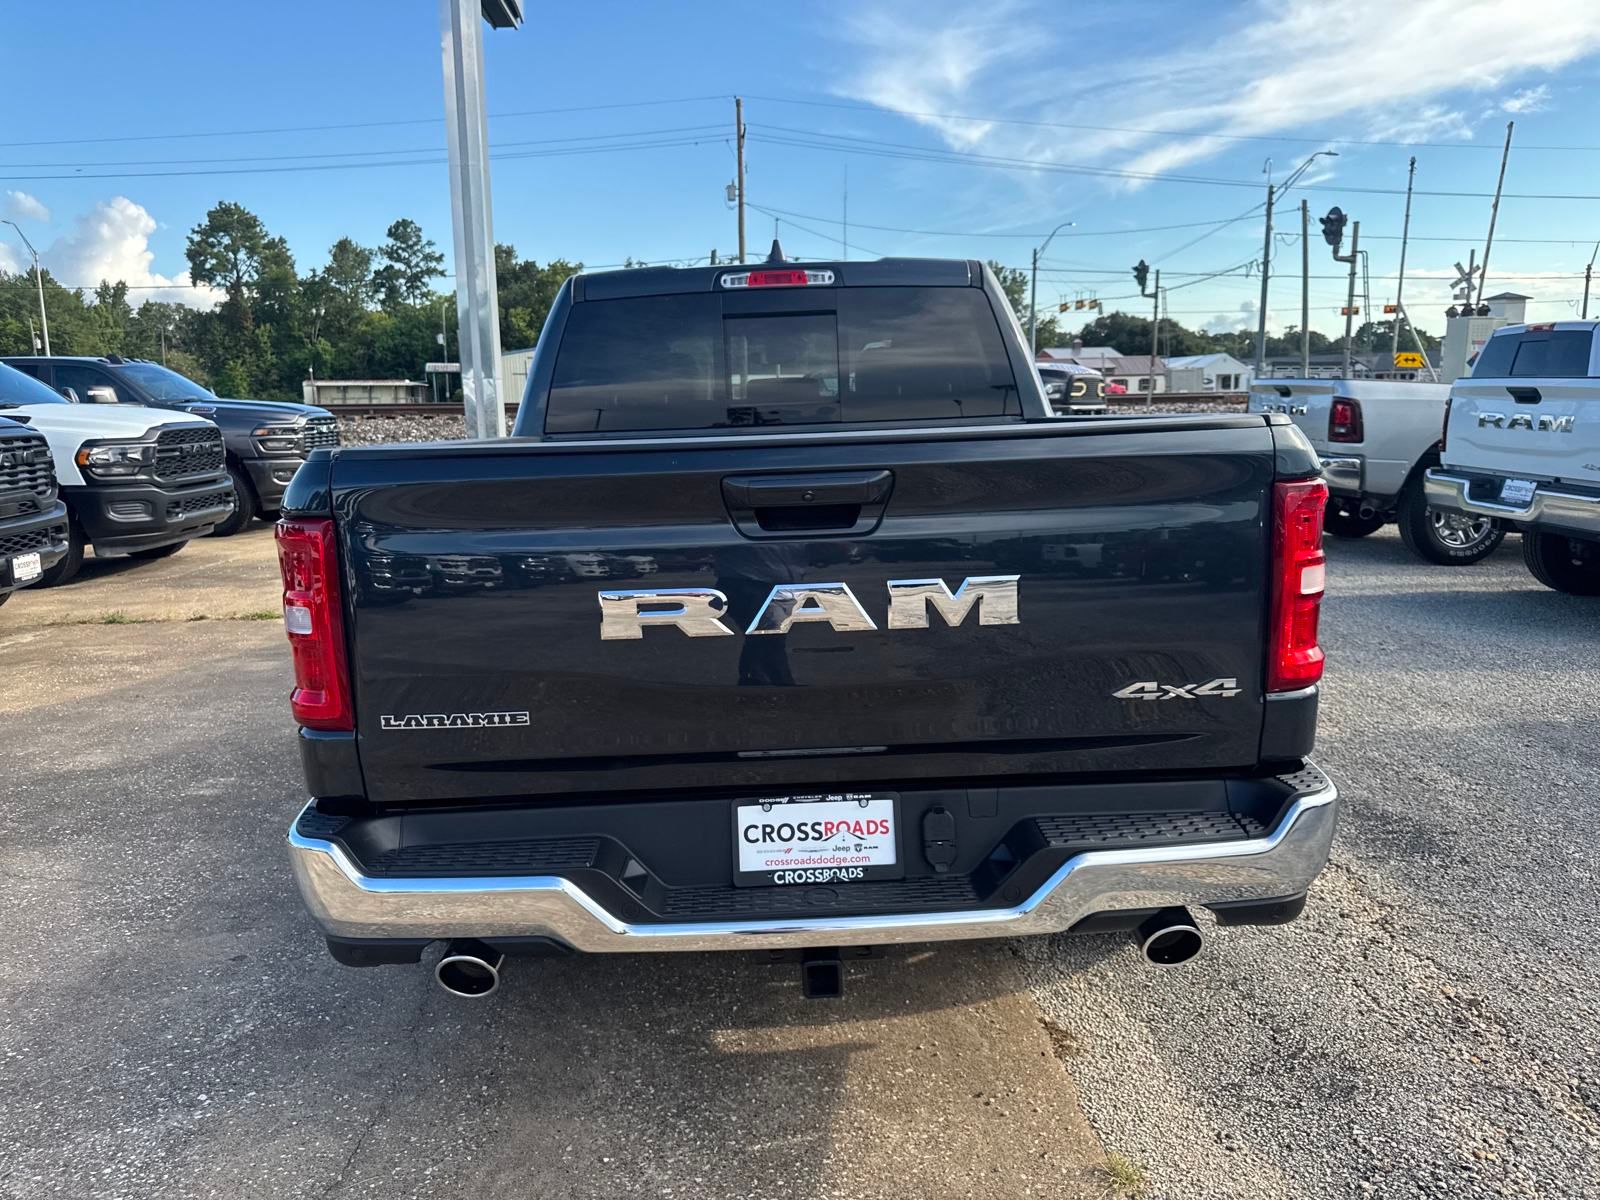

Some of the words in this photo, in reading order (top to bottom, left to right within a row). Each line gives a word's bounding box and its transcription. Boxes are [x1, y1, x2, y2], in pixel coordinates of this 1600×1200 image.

[1478, 411, 1575, 433] RAM
[0, 451, 33, 465] AM
[598, 575, 1020, 640] RAM
[1112, 678, 1242, 700] 4x4
[380, 711, 530, 729] LARAMIE
[743, 819, 890, 843] CROSSROADS
[832, 844, 851, 852] Jeep
[765, 854, 871, 867] crossroadsdodge.com
[774, 867, 864, 884] CROSSROADS
